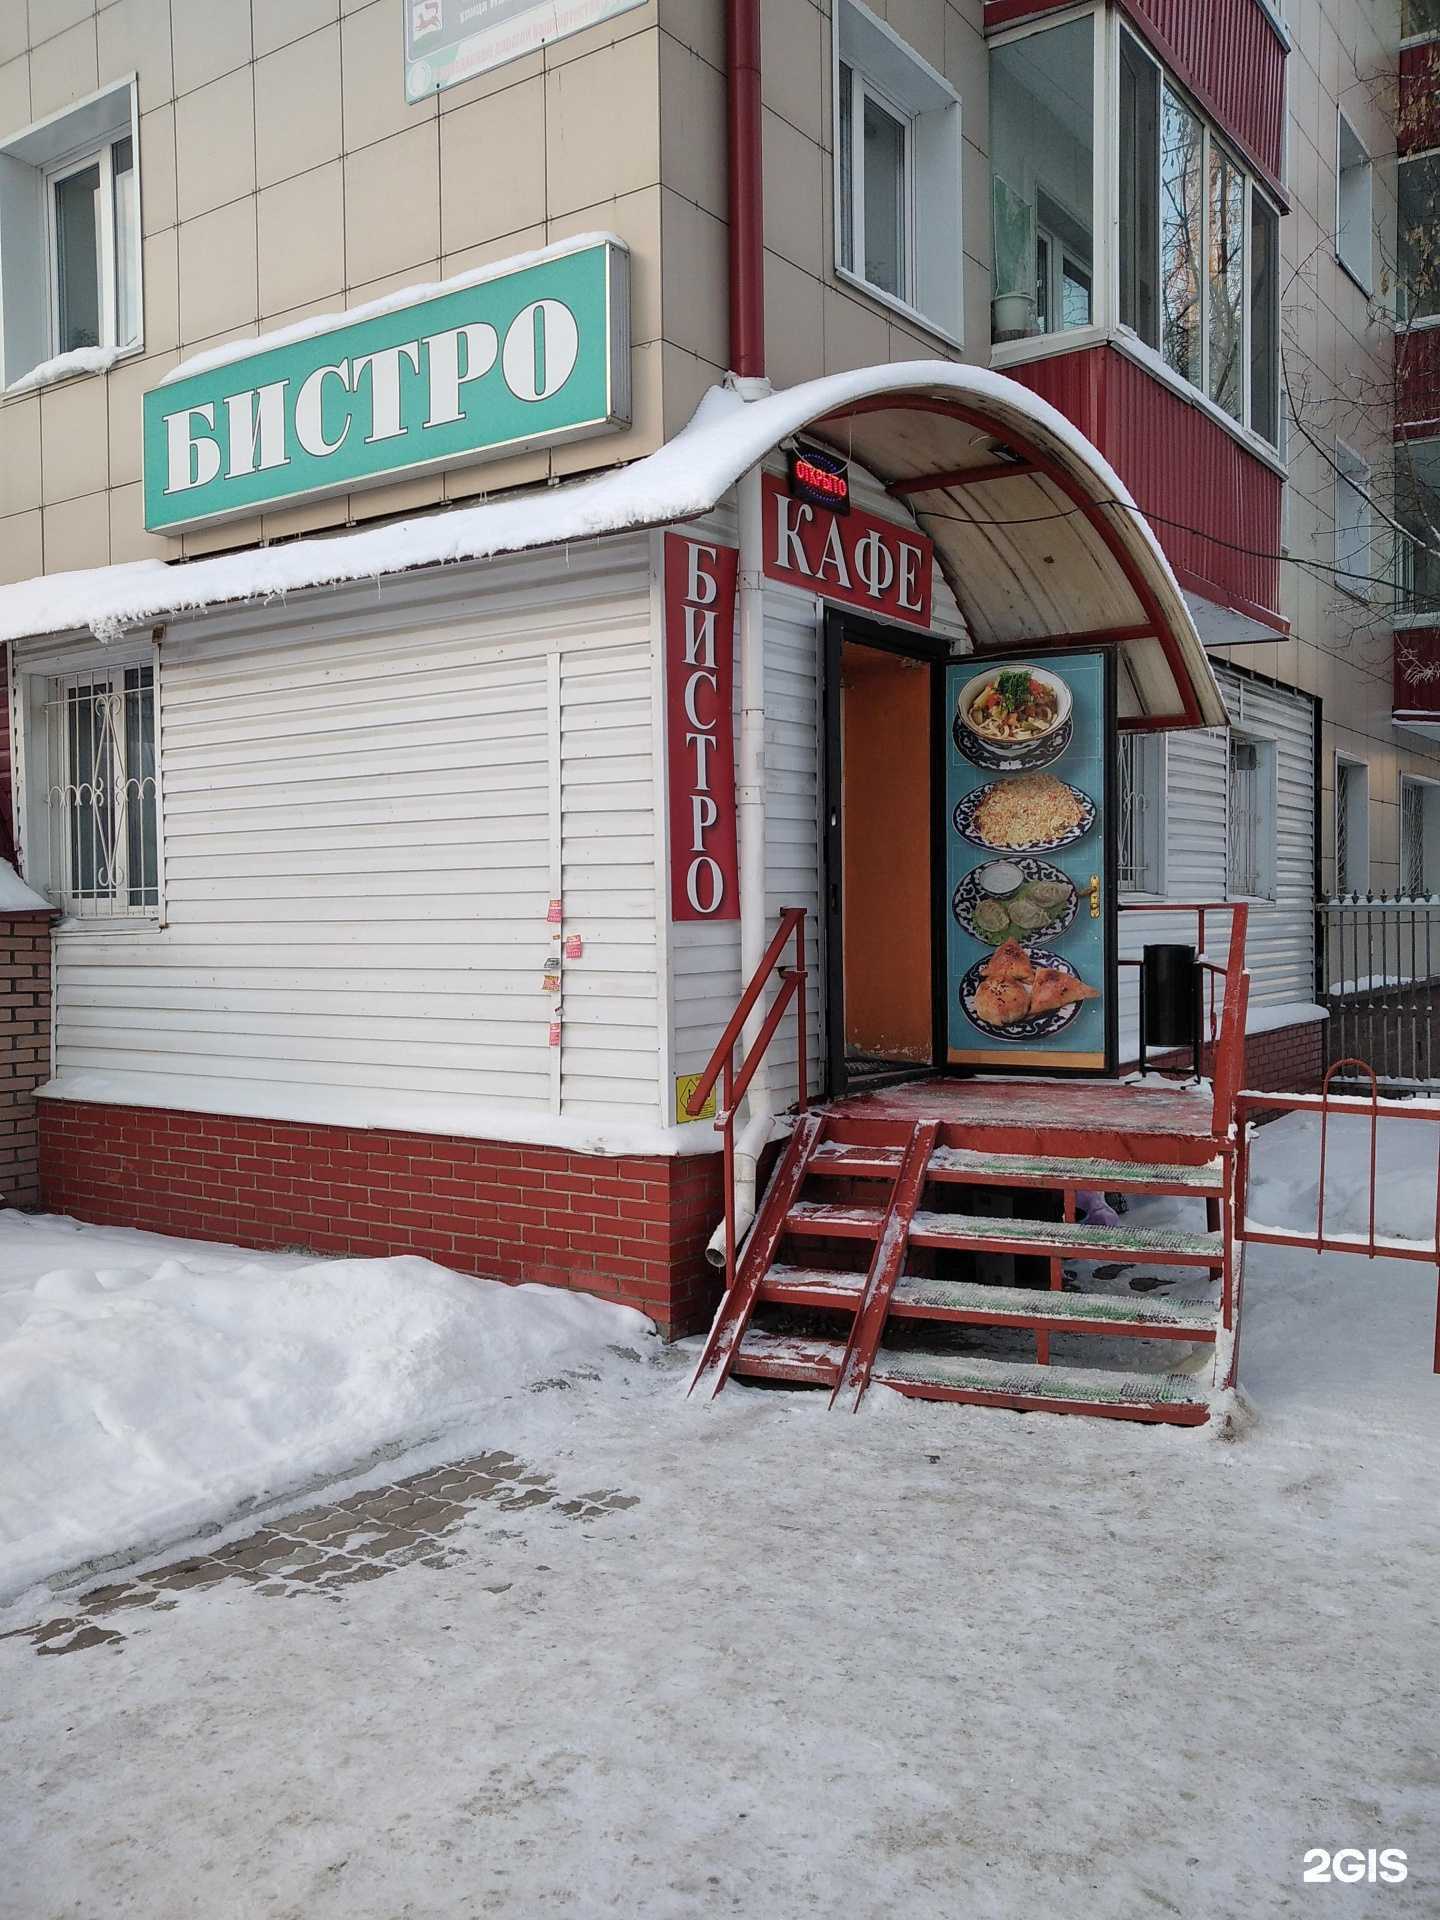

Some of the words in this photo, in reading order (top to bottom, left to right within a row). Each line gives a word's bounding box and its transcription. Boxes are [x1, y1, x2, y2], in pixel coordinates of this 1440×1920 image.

[162, 298, 580, 495] БИСТРО
[772, 492, 923, 612] КАФЕ
[796, 460, 847, 497] ОТКРЫТО
[681, 540, 724, 914] БИСТРО
